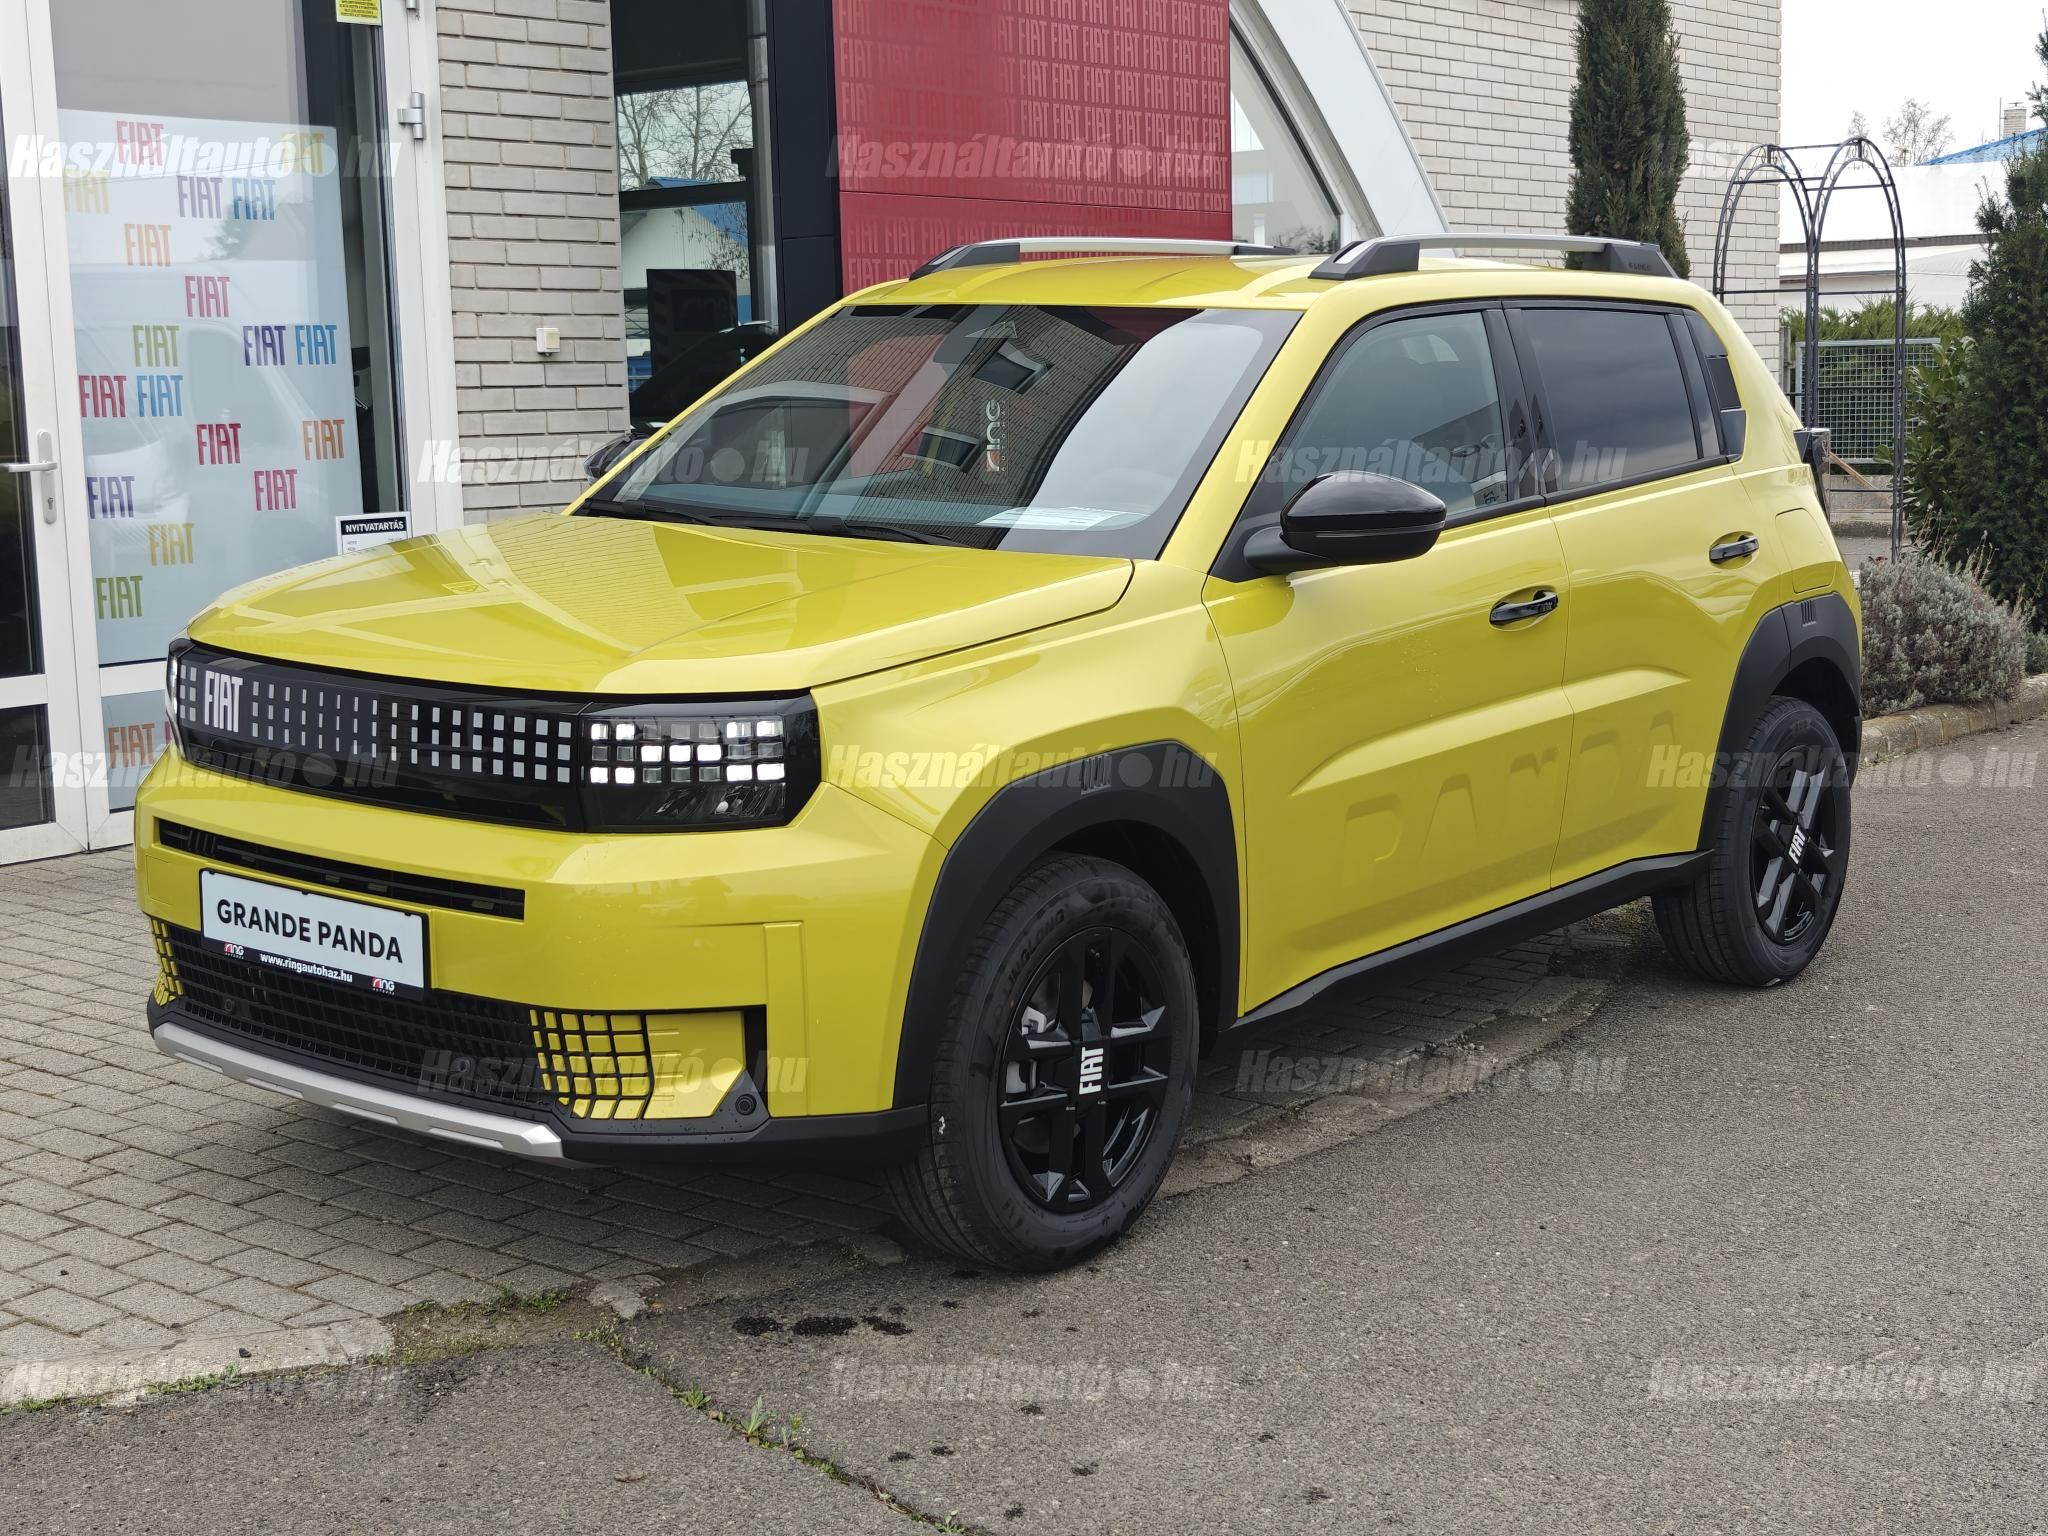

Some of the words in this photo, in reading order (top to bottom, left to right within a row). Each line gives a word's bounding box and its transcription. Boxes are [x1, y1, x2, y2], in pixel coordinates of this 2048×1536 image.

[1113, 0, 1137, 28] FIAT
[1143, 0, 1166, 33] FIAT
[1172, 2, 1196, 37] FIAT
[1200, 5, 1224, 41] FIAT
[1018, 17, 1047, 57] FIAT
[1051, 21, 1078, 61] FIAT
[1083, 26, 1109, 64] FIAT
[1113, 30, 1139, 68] FIAT
[1143, 34, 1169, 72] FIAT
[1172, 38, 1197, 76] FIAT
[1201, 42, 1225, 79] FIAT
[840, 37, 873, 79] FIAT
[1019, 59, 1048, 98] FIAT
[1052, 63, 1080, 101] FIAT
[1084, 67, 1110, 104] FIAT
[1114, 70, 1140, 108] FIAT
[1144, 74, 1169, 110] FIAT
[1173, 78, 1198, 112] FIAT
[1201, 81, 1226, 115] FIAT
[116, 120, 164, 166] FIAT
[1021, 101, 1049, 137] FIAT
[1053, 104, 1080, 140] FIAT
[1085, 107, 1111, 142] FIAT
[1115, 110, 1141, 146] FIAT
[1145, 113, 1170, 149] FIAT
[1174, 116, 1199, 151] FIAT
[1202, 118, 1226, 153] FIAT
[1086, 145, 1112, 182] FIAT
[1117, 148, 1143, 184] FIAT
[1147, 151, 1171, 185] FIAT
[1175, 153, 1199, 189] FIAT
[1203, 155, 1227, 190] FIAT
[177, 175, 223, 218] FIAT
[231, 177, 275, 220] FIAT
[124, 223, 171, 267] FIAT
[885, 216, 917, 255] FIAT
[184, 275, 230, 317] FIAT
[132, 325, 179, 367] FIAT
[244, 325, 286, 366] FIAT
[295, 324, 336, 366] FIAT
[79, 375, 127, 417] FIAT
[136, 374, 183, 417] FIAT
[197, 423, 241, 465] FIAT
[302, 418, 345, 460] FIAT
[87, 475, 135, 518] FIAT
[255, 469, 297, 511] FIAT
[148, 523, 194, 566] FIAT
[345, 519, 404, 533] NYITVATARTÁS
[96, 576, 143, 619] FIAT
[204, 670, 243, 733] FIAT
[107, 722, 155, 769] FIAT
[1789, 825, 1806, 864] FIAT
[217, 899, 311, 943] GRANDE
[318, 920, 403, 964] PANDA
[259, 951, 353, 983] www.ringautohaz.hu
[1079, 1046, 1104, 1095] FIAT
